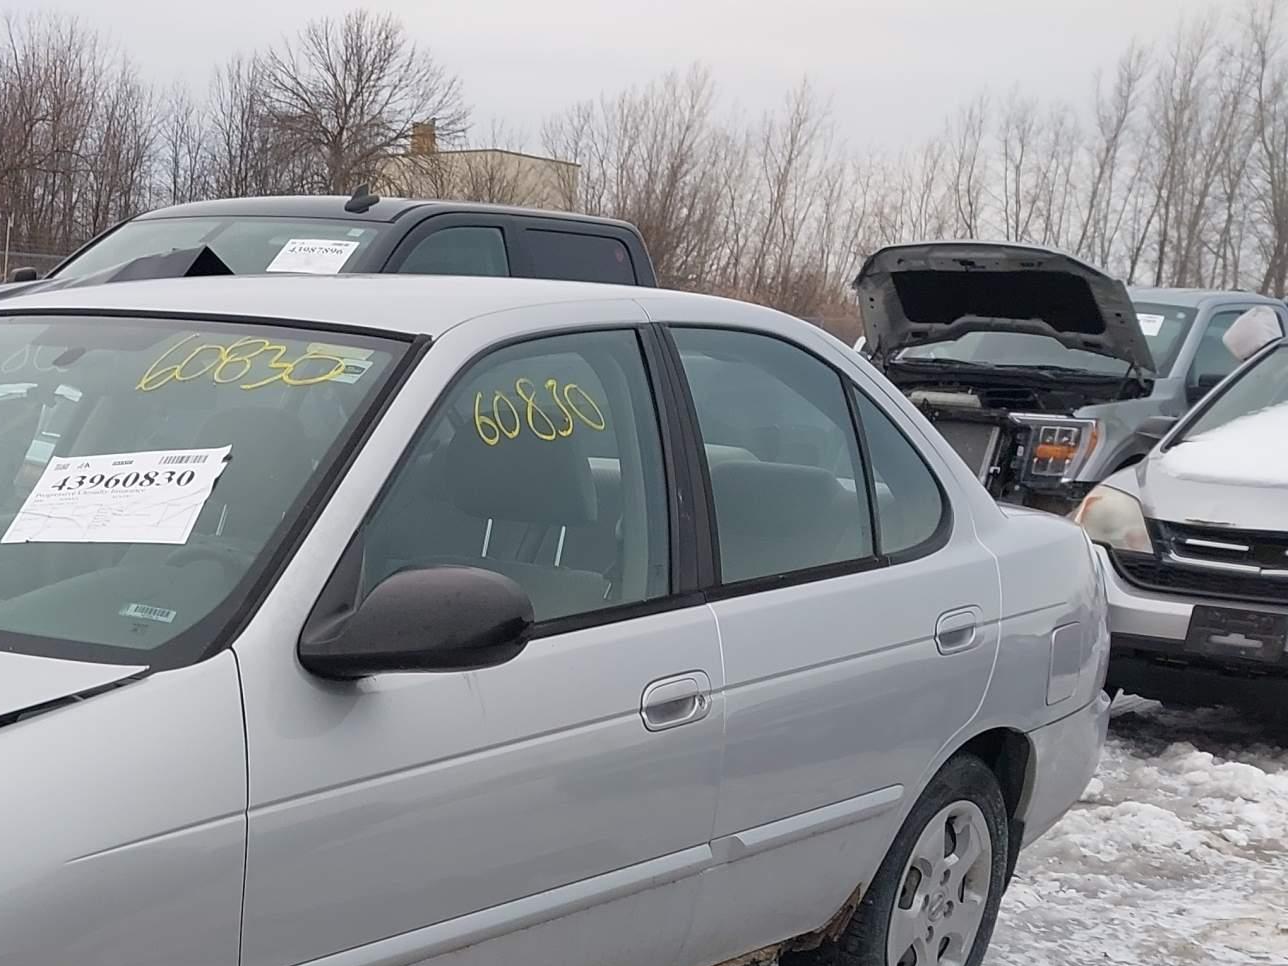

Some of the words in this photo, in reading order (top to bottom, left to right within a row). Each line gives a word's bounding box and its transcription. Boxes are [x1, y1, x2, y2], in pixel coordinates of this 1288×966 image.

[135, 333, 345, 392] 60830
[474, 378, 605, 446] 60830
[51, 470, 196, 491] 43960830
